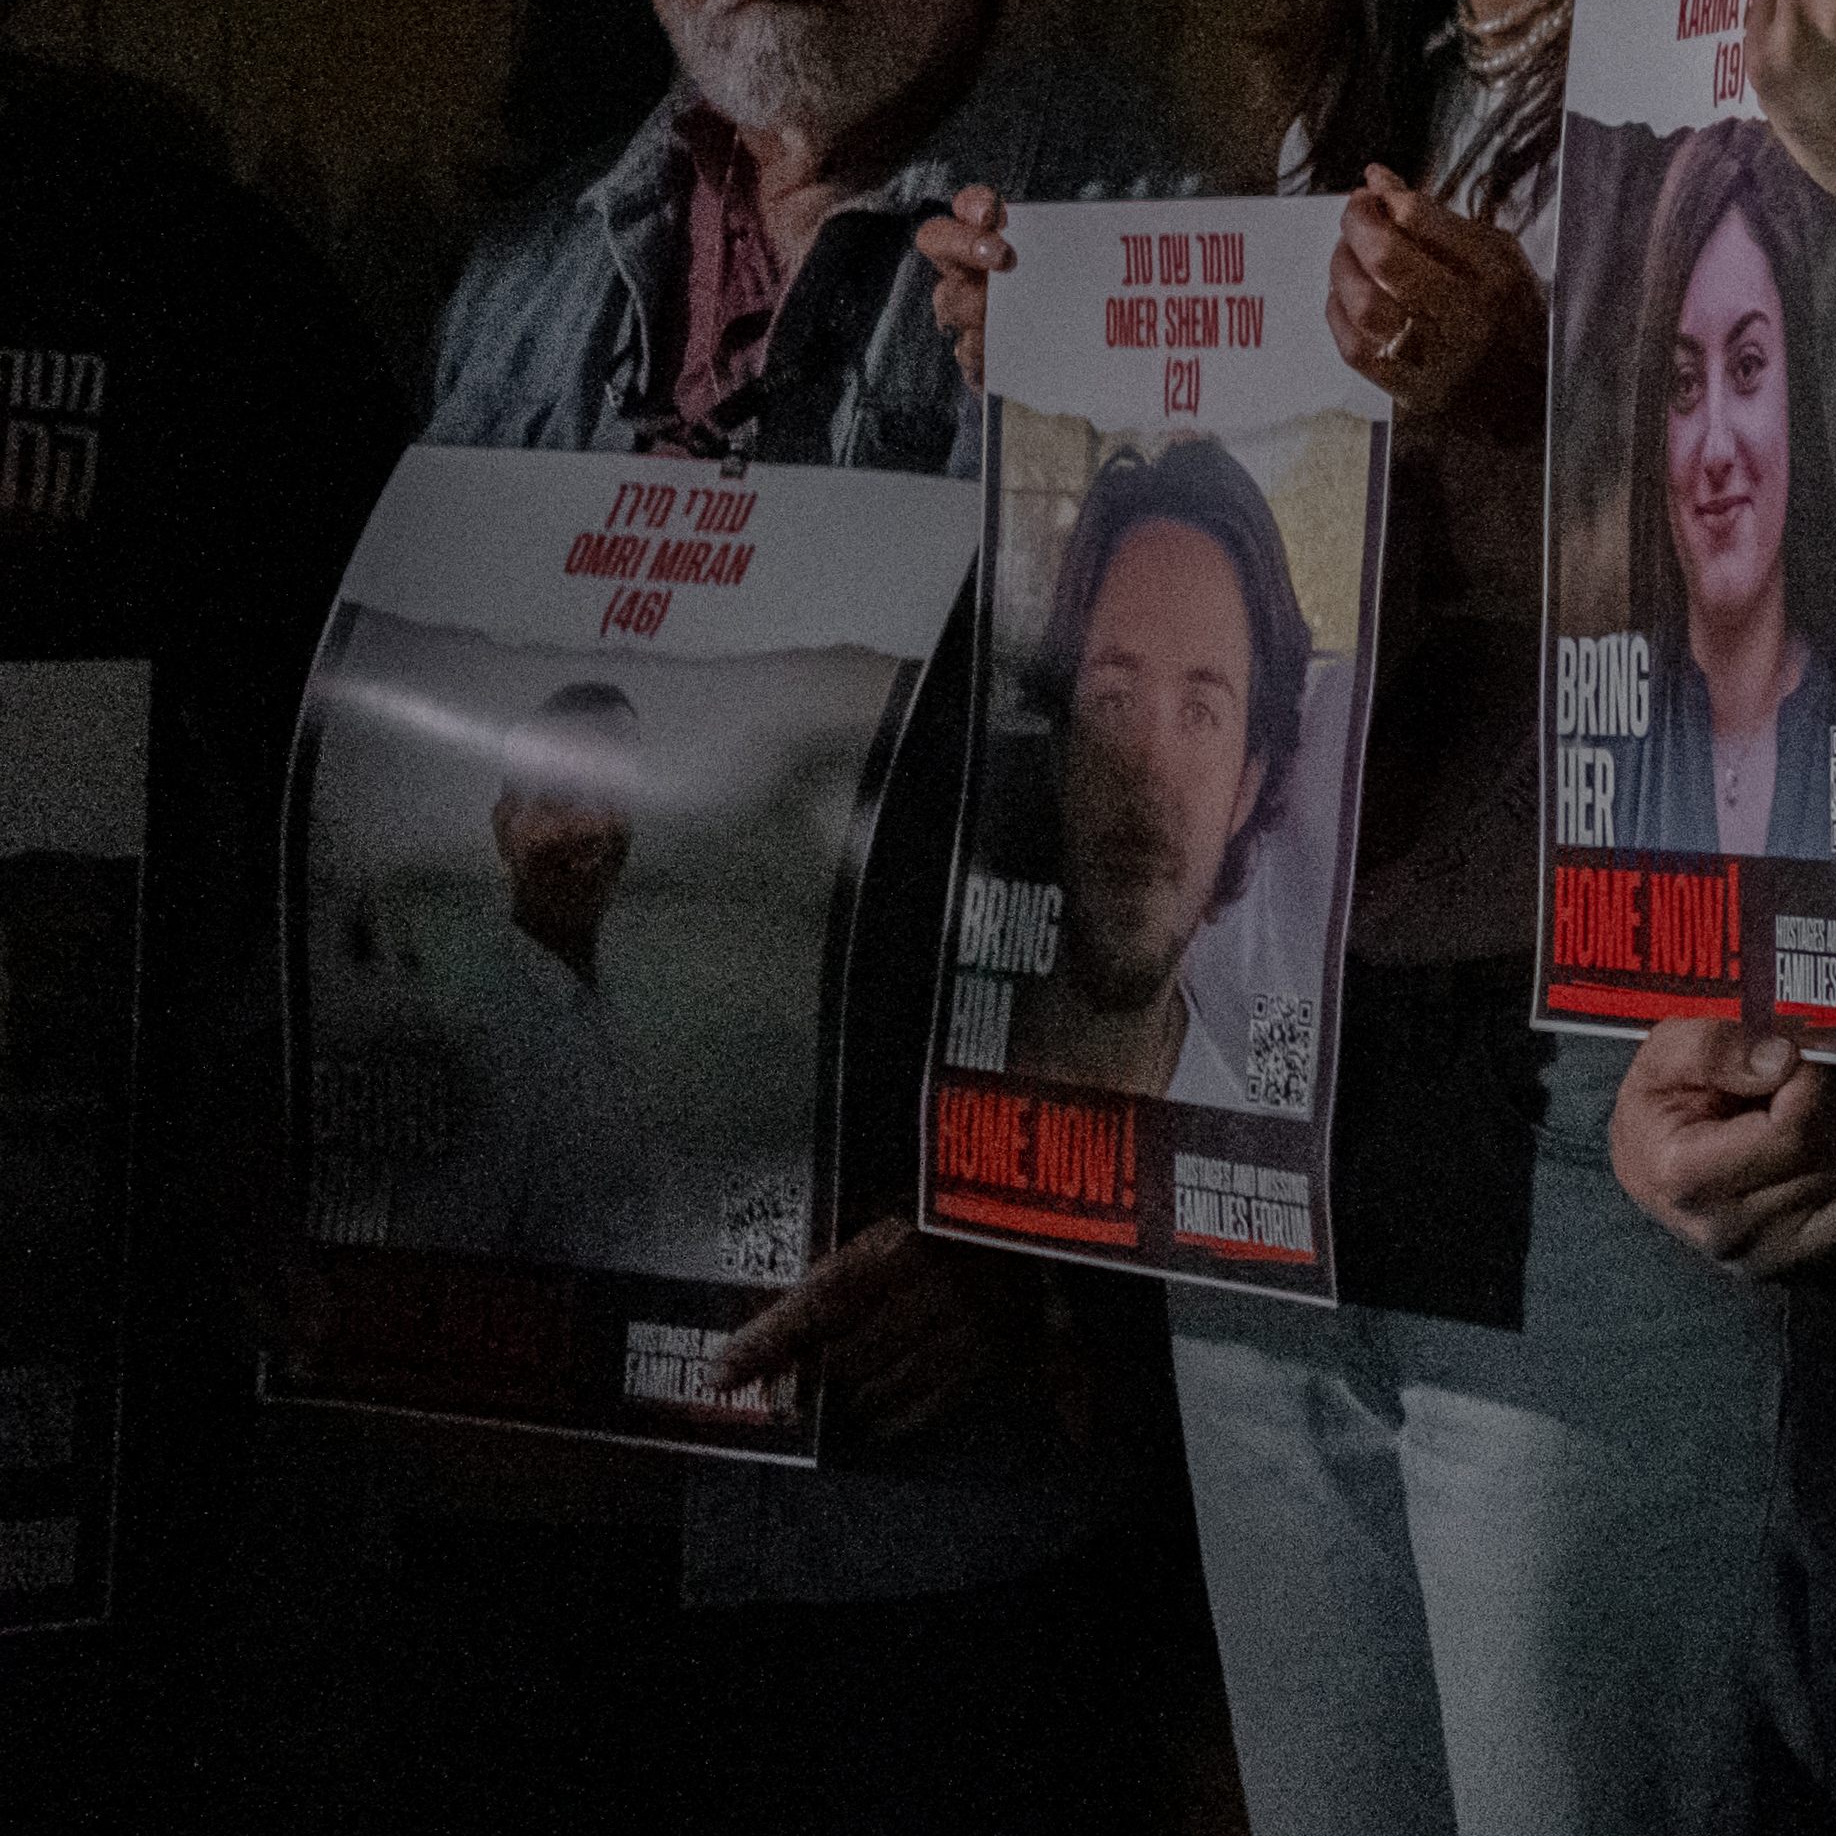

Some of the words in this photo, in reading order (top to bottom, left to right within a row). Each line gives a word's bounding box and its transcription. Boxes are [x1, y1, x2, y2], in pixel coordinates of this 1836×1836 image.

[1713, 41, 1745, 108] (19)
[1120, 234, 1153, 287] טוב
[1158, 232, 1190, 285] שם
[1196, 232, 1244, 285] עומר
[1106, 296, 1158, 348] OMER
[1164, 296, 1219, 348] SHEM
[1225, 296, 1264, 348] TOV
[1164, 356, 1199, 417] (21)
[605, 482, 677, 530] מירן
[684, 488, 757, 533] עמרי
[565, 532, 651, 580] OMRI
[647, 538, 755, 585] MIRAN
[600, 586, 672, 639] (46)
[1556, 631, 1650, 738] BRING
[1556, 745, 1615, 847] HER
[956, 872, 1063, 976] BRING
[1554, 866, 1642, 971] HOME
[1649, 862, 1741, 981] NOW!
[1775, 914, 1826, 953] HOSTAGES
[937, 1086, 1030, 1190] HOME
[1037, 1098, 1136, 1210] NOW!
[1175, 1186, 1249, 1242] FAMILIES
[1250, 1198, 1313, 1253] FORUM
